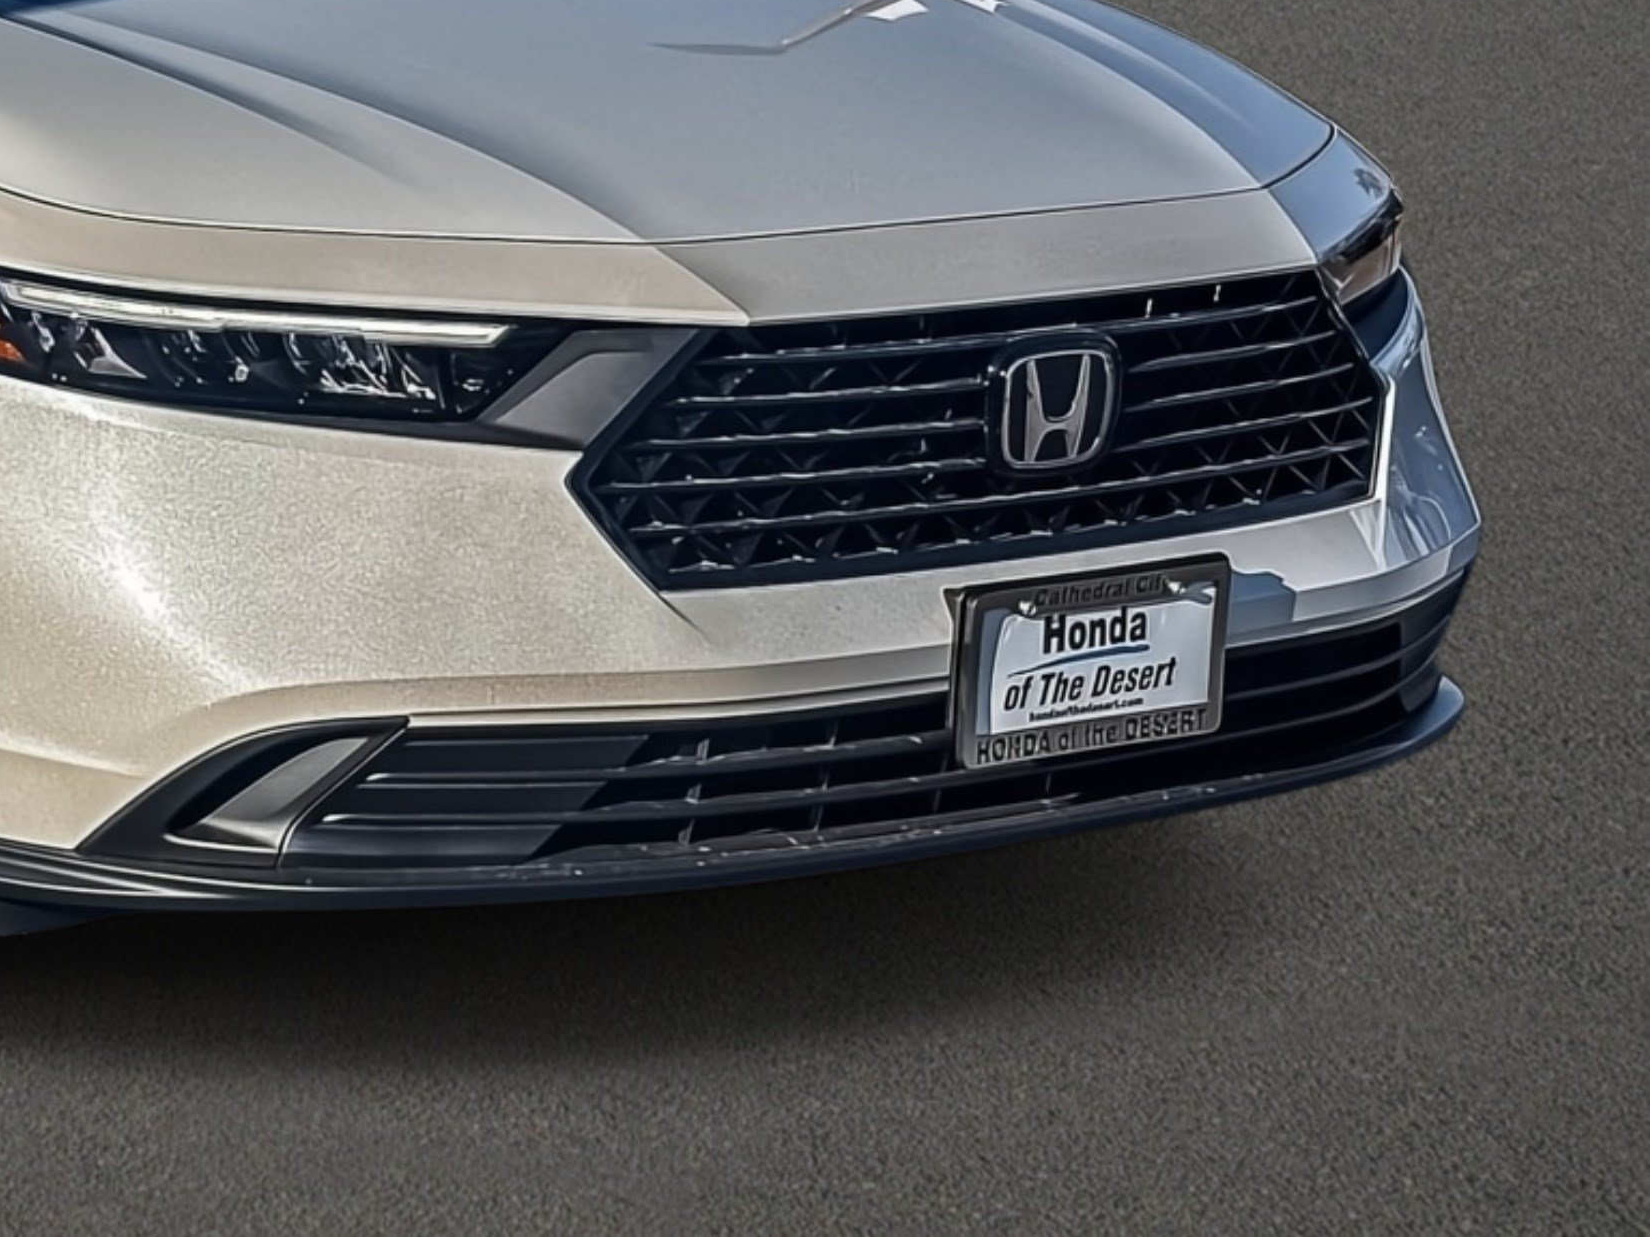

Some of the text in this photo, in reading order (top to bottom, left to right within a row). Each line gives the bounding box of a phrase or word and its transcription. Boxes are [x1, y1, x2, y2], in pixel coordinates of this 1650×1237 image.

[1034, 577, 1130, 606] Cathedral
[1042, 606, 1147, 654] Honda
[1003, 656, 1177, 711] of The Desert
[976, 708, 1207, 764] HONDA of the DESERT
